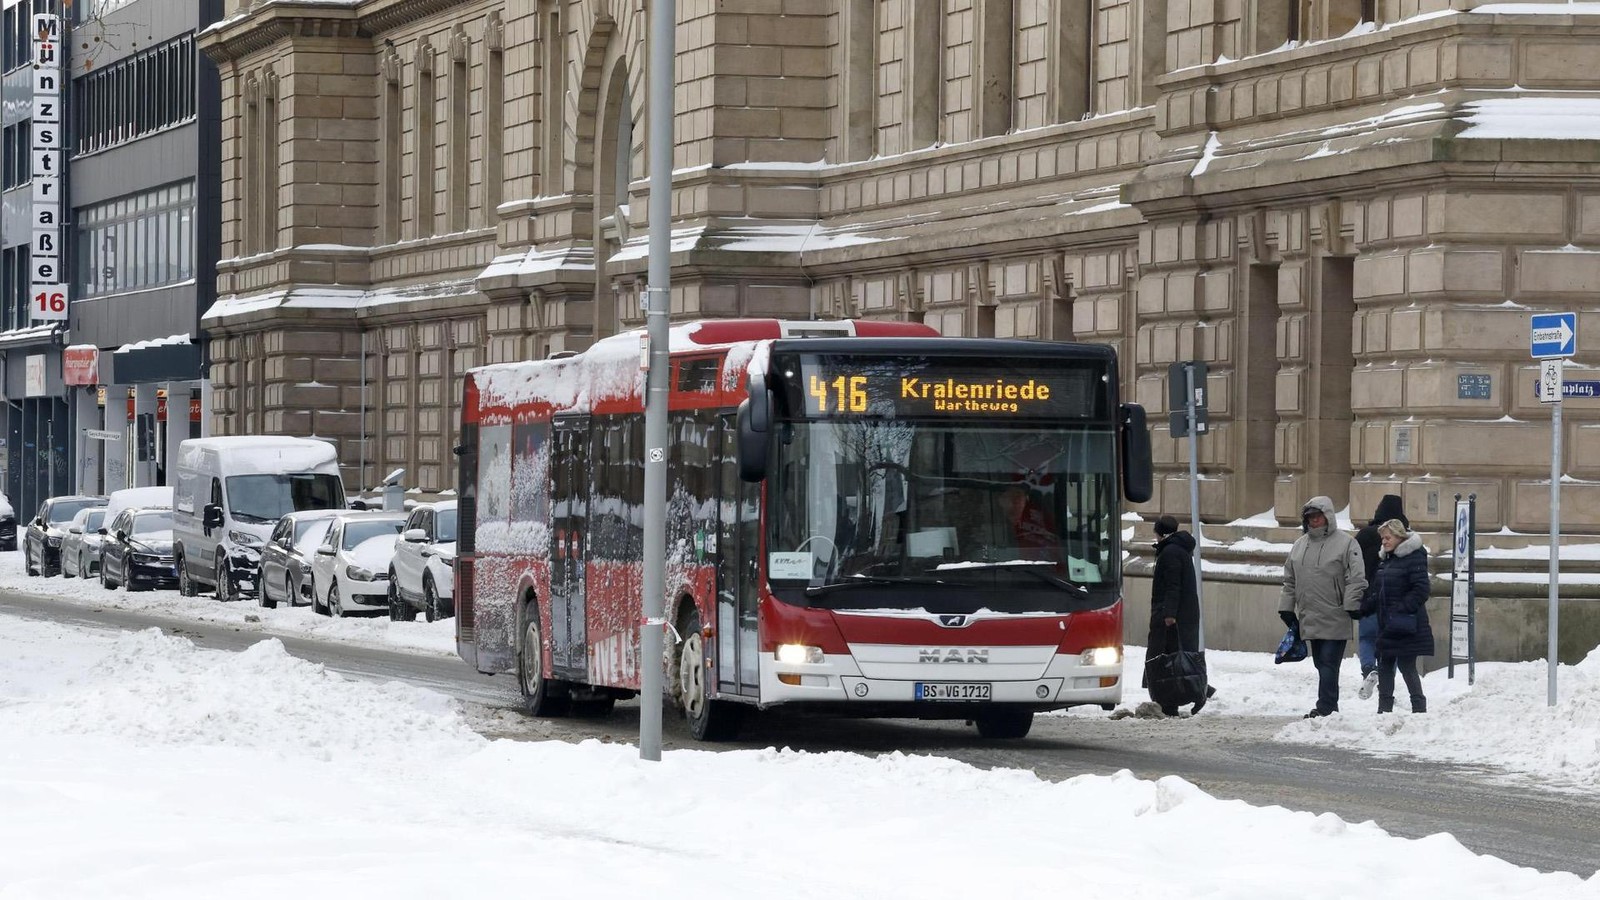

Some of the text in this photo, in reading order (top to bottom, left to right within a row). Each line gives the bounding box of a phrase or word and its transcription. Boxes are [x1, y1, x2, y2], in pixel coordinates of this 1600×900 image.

[37, 18, 57, 278] Münzstraße
[35, 292, 65, 313] 16
[1534, 330, 1562, 341] Einbahnstraße
[810, 375, 1050, 412] 416 Kralenriede
[935, 400, 1018, 412] Wartheweg
[919, 648, 989, 663] MAN
[923, 685, 989, 698] BS VG 1712
